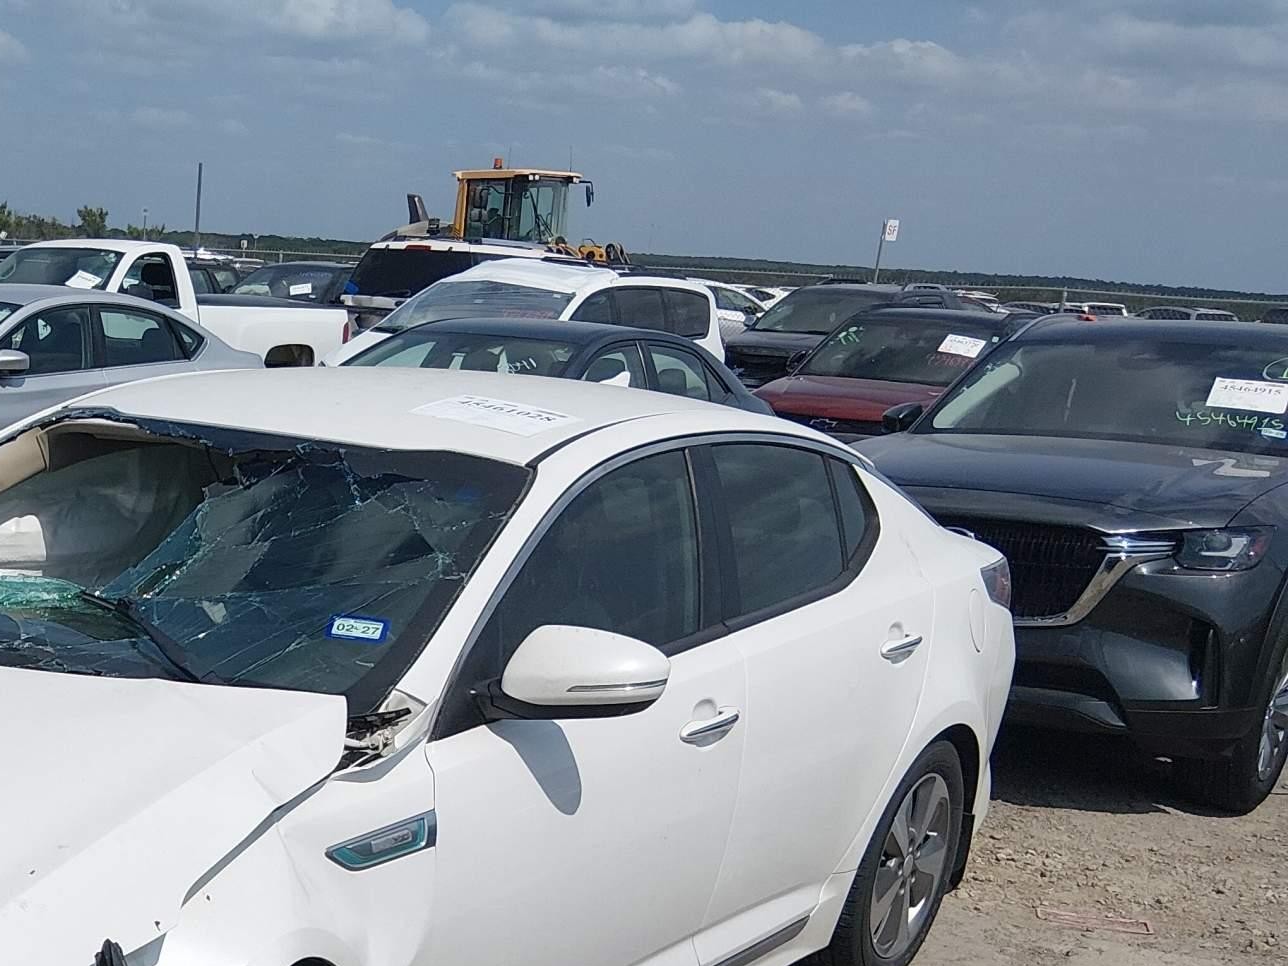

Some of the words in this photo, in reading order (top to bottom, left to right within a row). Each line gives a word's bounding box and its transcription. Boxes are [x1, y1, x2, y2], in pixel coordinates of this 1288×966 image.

[1218, 384, 1282, 395] 45464915
[458, 400, 558, 422] 45461028
[1175, 411, 1285, 431] 45464915
